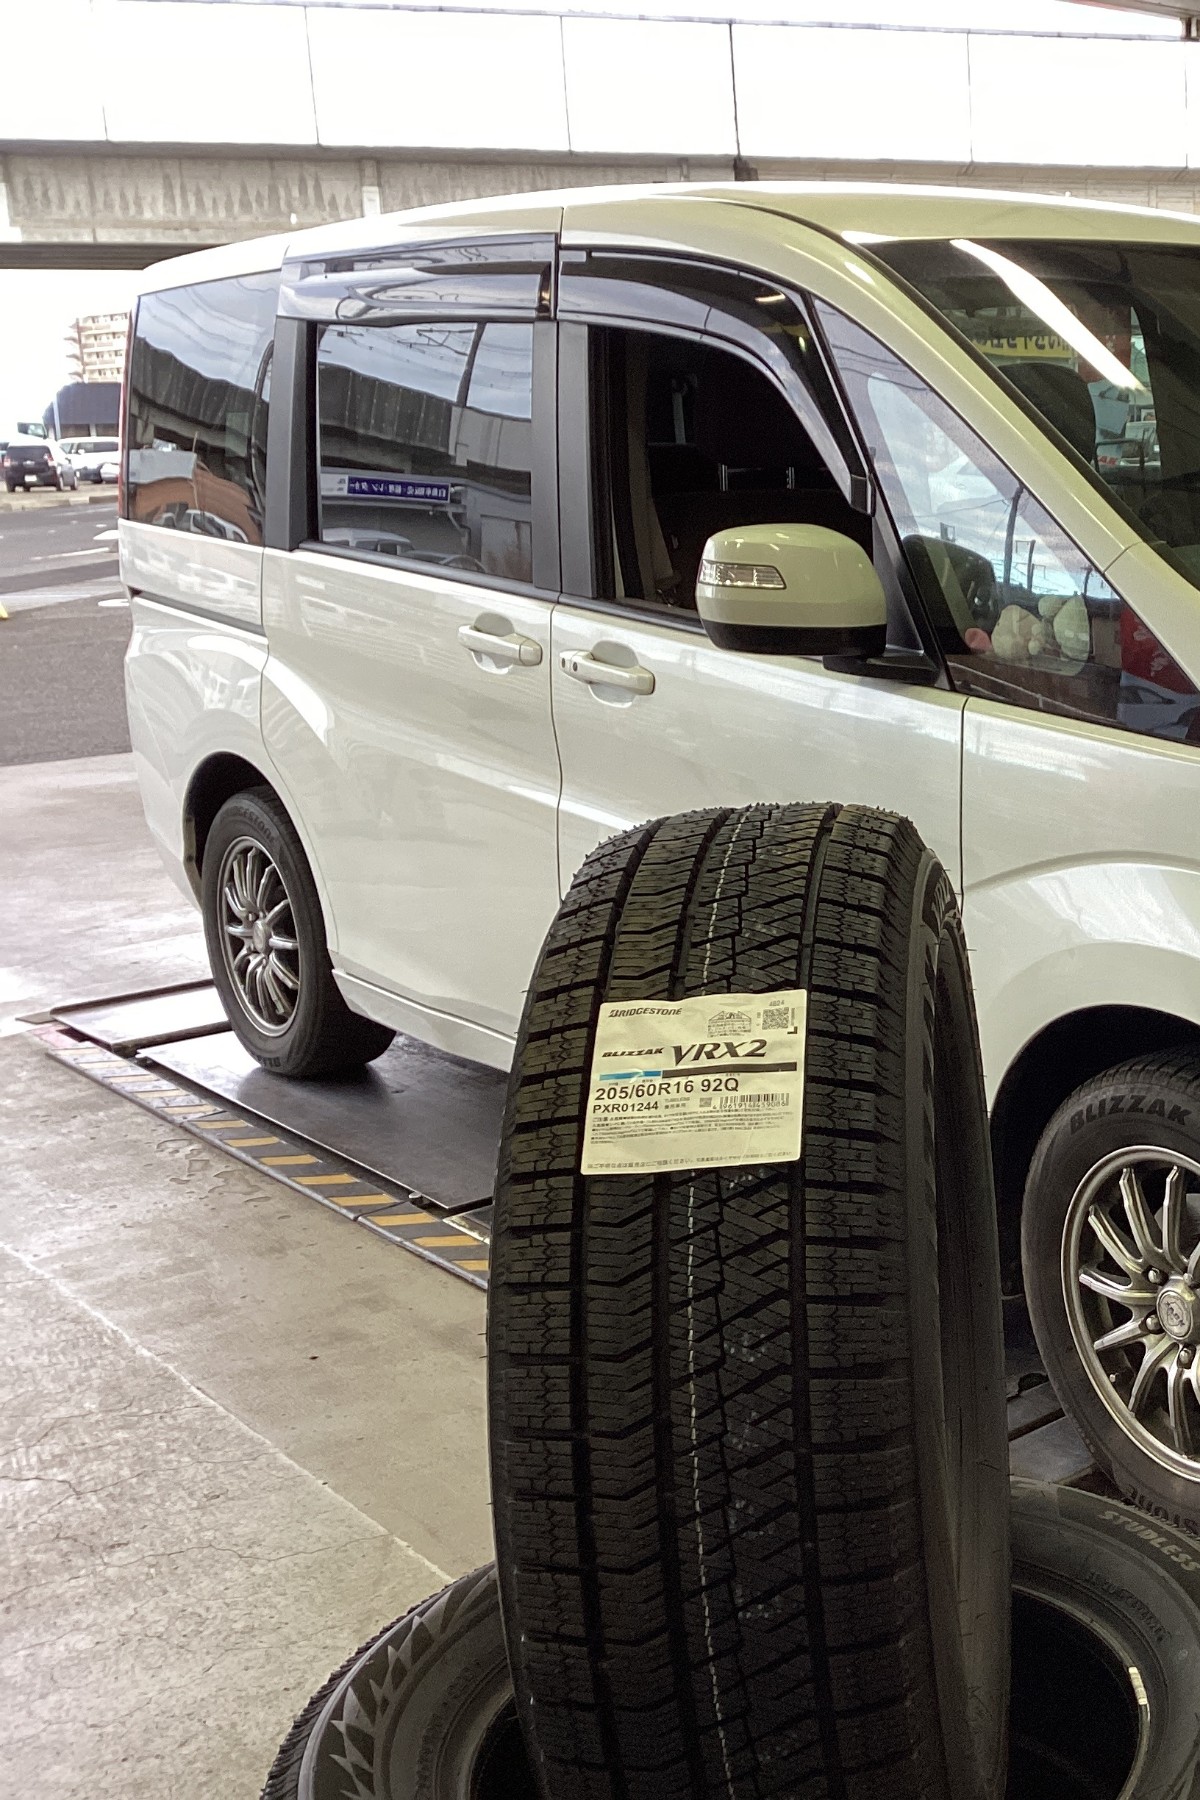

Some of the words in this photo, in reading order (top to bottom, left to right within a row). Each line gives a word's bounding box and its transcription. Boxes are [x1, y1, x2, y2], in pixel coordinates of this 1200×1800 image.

[608, 1007, 683, 1018] BRIDGESTONE
[601, 1047, 665, 1058] BLIZZAK
[671, 1038, 768, 1066] VRX2
[594, 1080, 694, 1101] 205/60R16
[701, 1077, 739, 1093] 92Q
[593, 1101, 659, 1114] PXR01244
[1070, 1095, 1192, 1135] BLIZZAK
